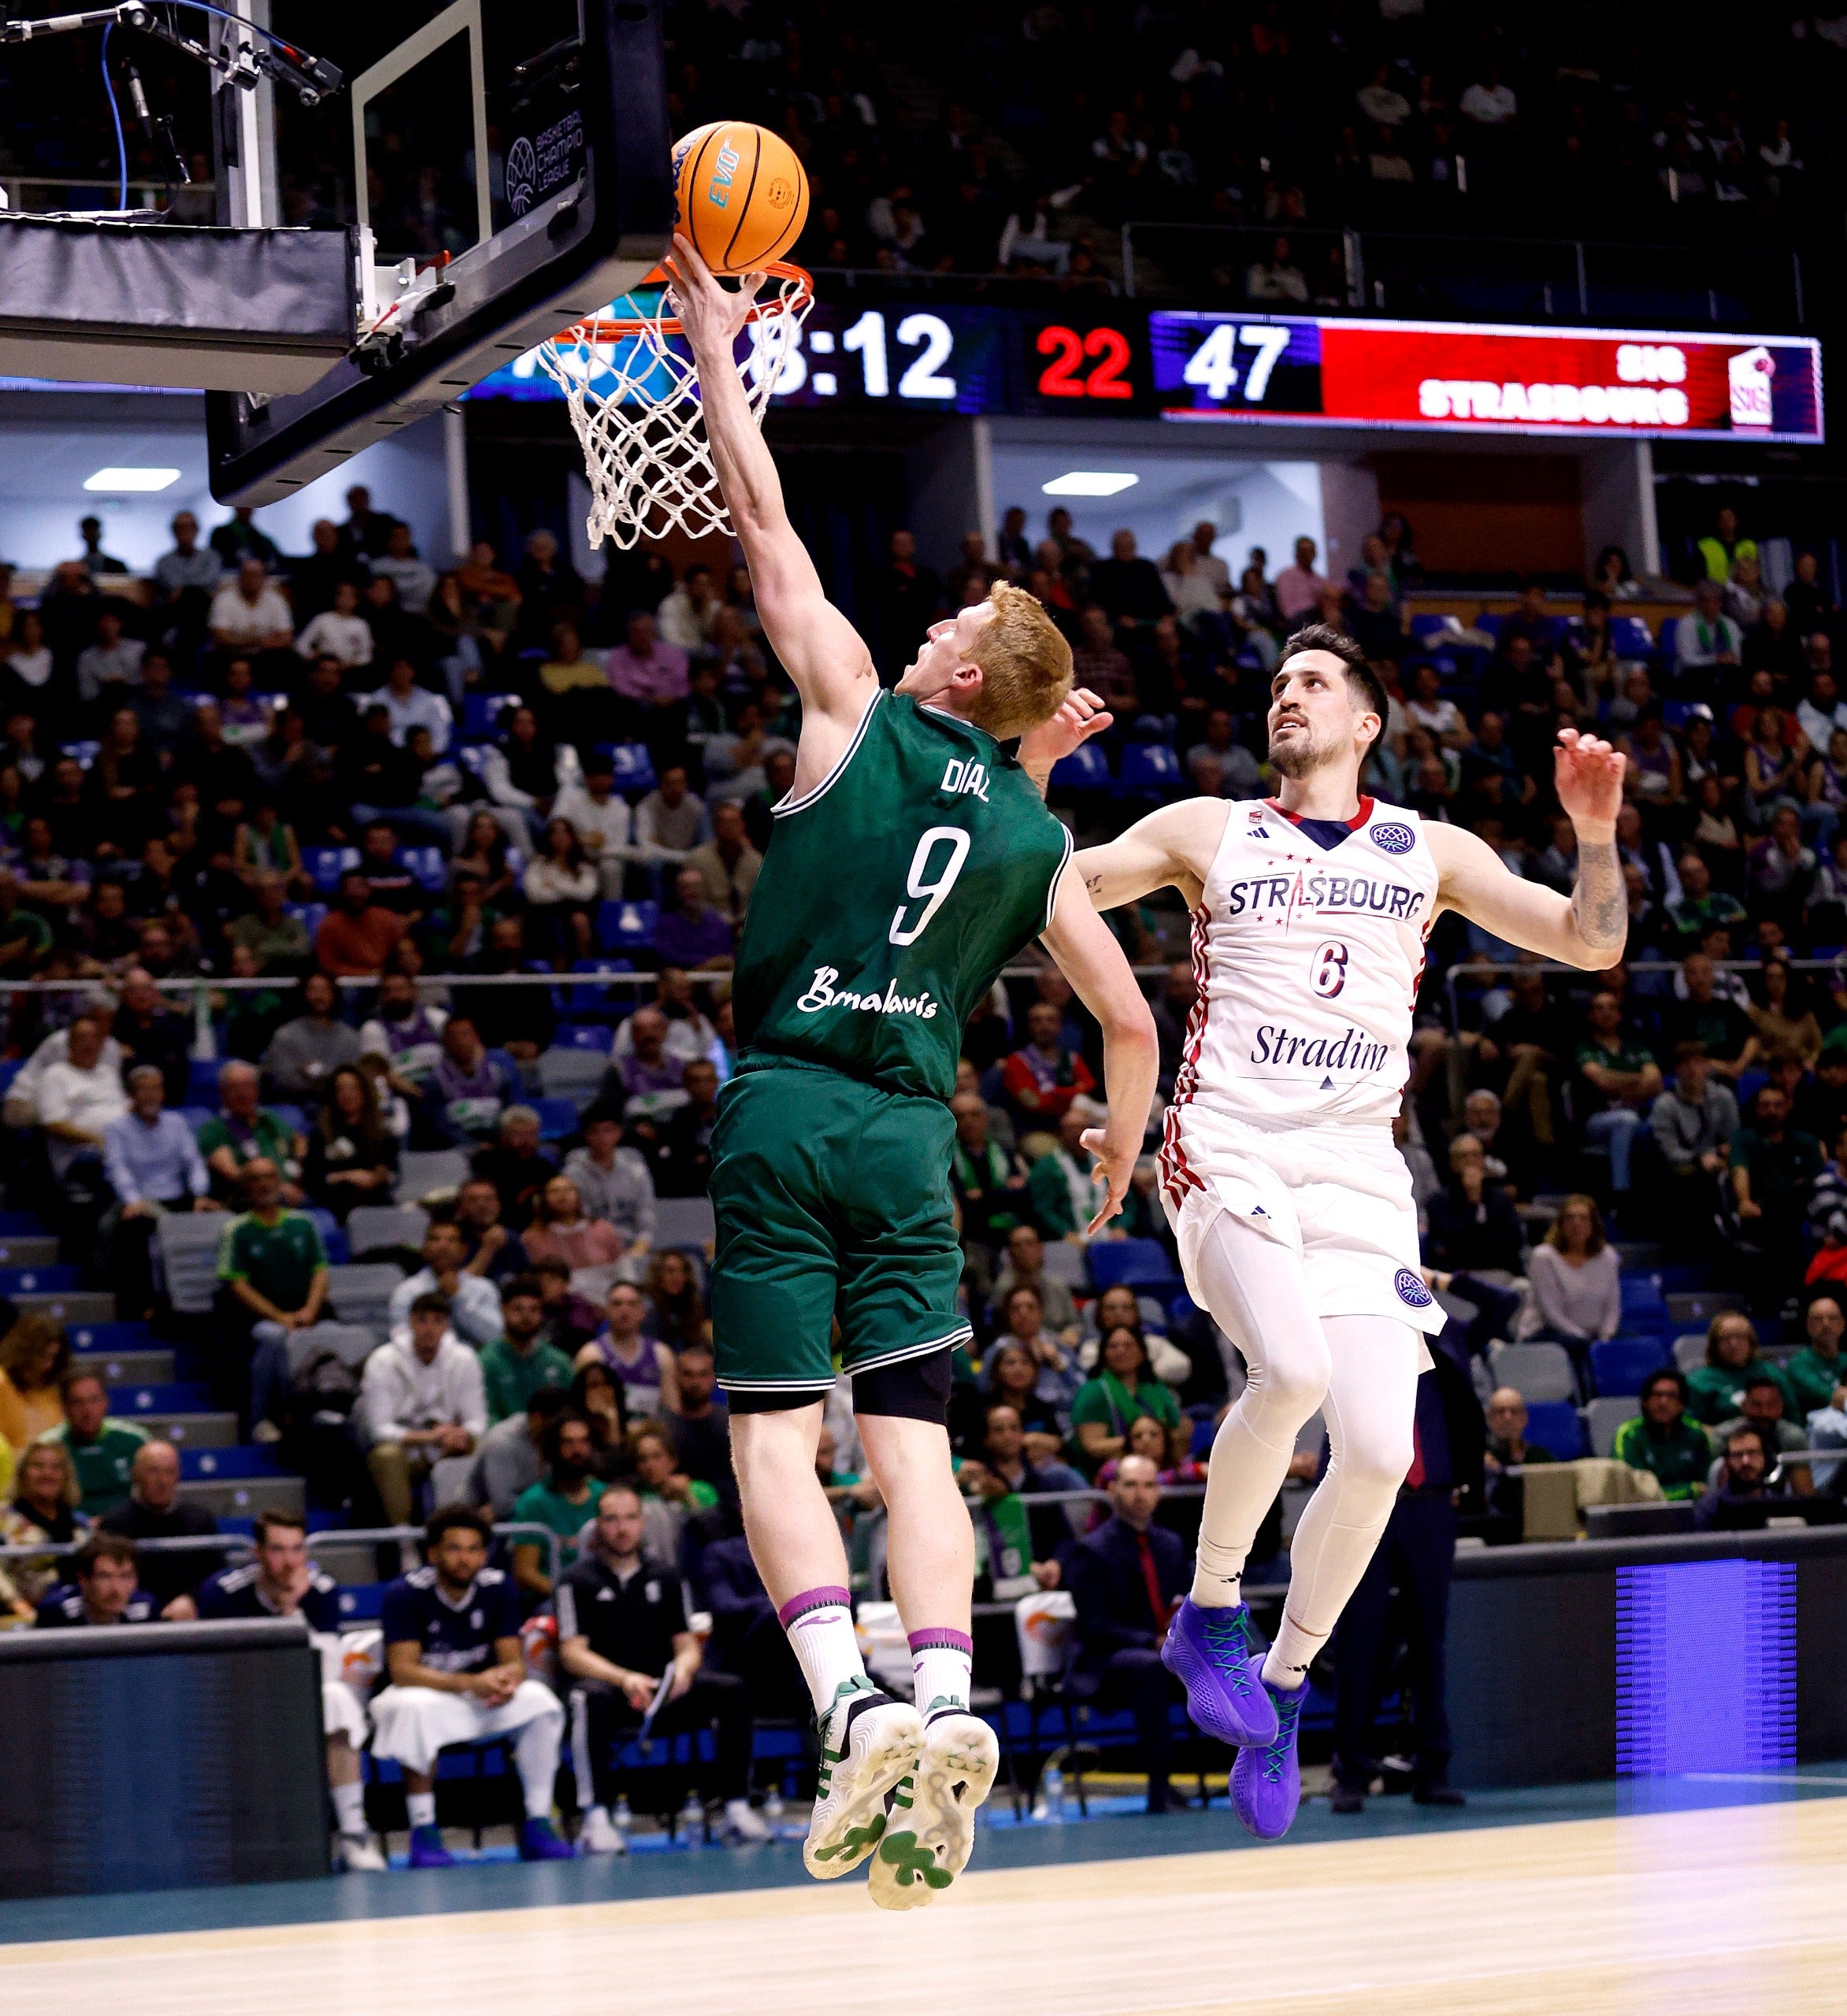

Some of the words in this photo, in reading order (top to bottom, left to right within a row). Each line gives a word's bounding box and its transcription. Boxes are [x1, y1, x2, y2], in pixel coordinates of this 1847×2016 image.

[538, 158, 570, 191] LEAGUE
[748, 312, 957, 399] 8:12
[1037, 326, 1133, 399] 22
[1184, 324, 1292, 401] 47
[1616, 344, 1686, 383] SIG
[1419, 379, 1689, 425] STRASBOURG
[888, 826, 971, 947] 9
[1229, 869, 1425, 921] STRASBOURG
[1309, 940, 1348, 999] 6
